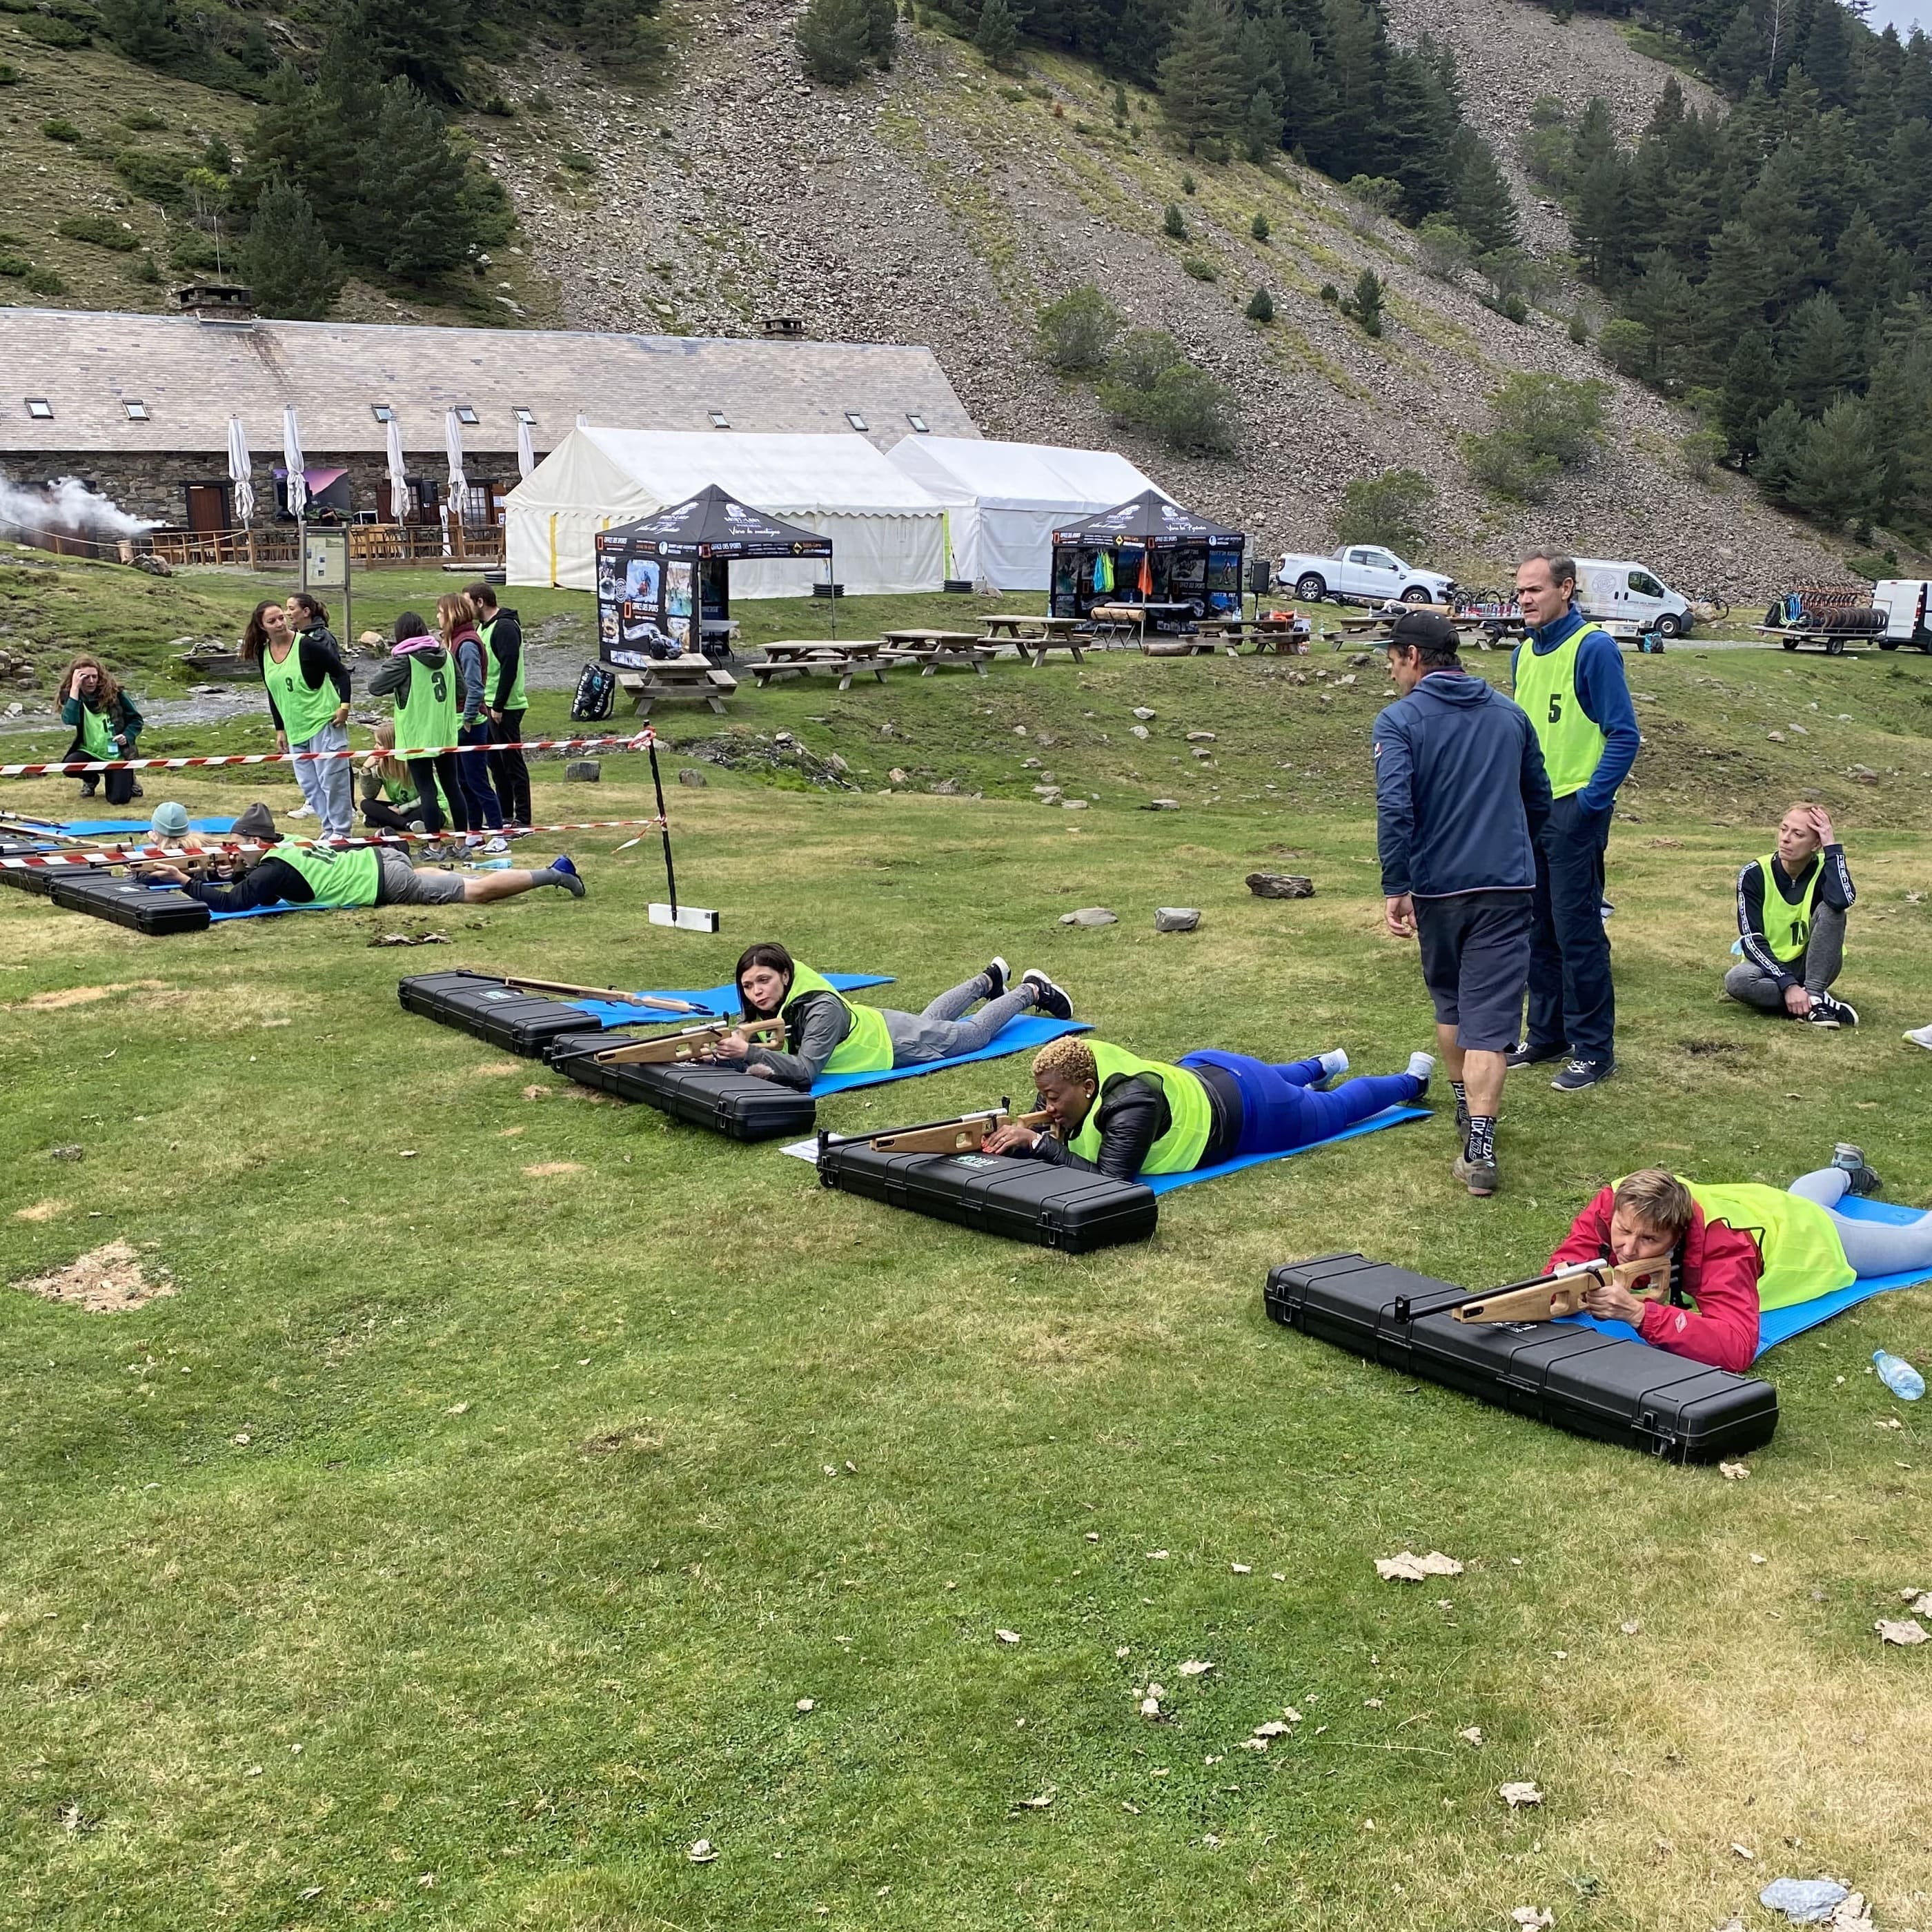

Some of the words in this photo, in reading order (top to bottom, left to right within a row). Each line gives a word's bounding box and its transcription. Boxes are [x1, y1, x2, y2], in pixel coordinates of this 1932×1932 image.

[285, 677, 294, 692] 9
[1548, 693, 1562, 723] 5
[400, 790, 409, 802] 3
[1790, 920, 1809, 946] 10
[1452, 1082, 1466, 1101] FOX
[1482, 1135, 1495, 1160] FOX
